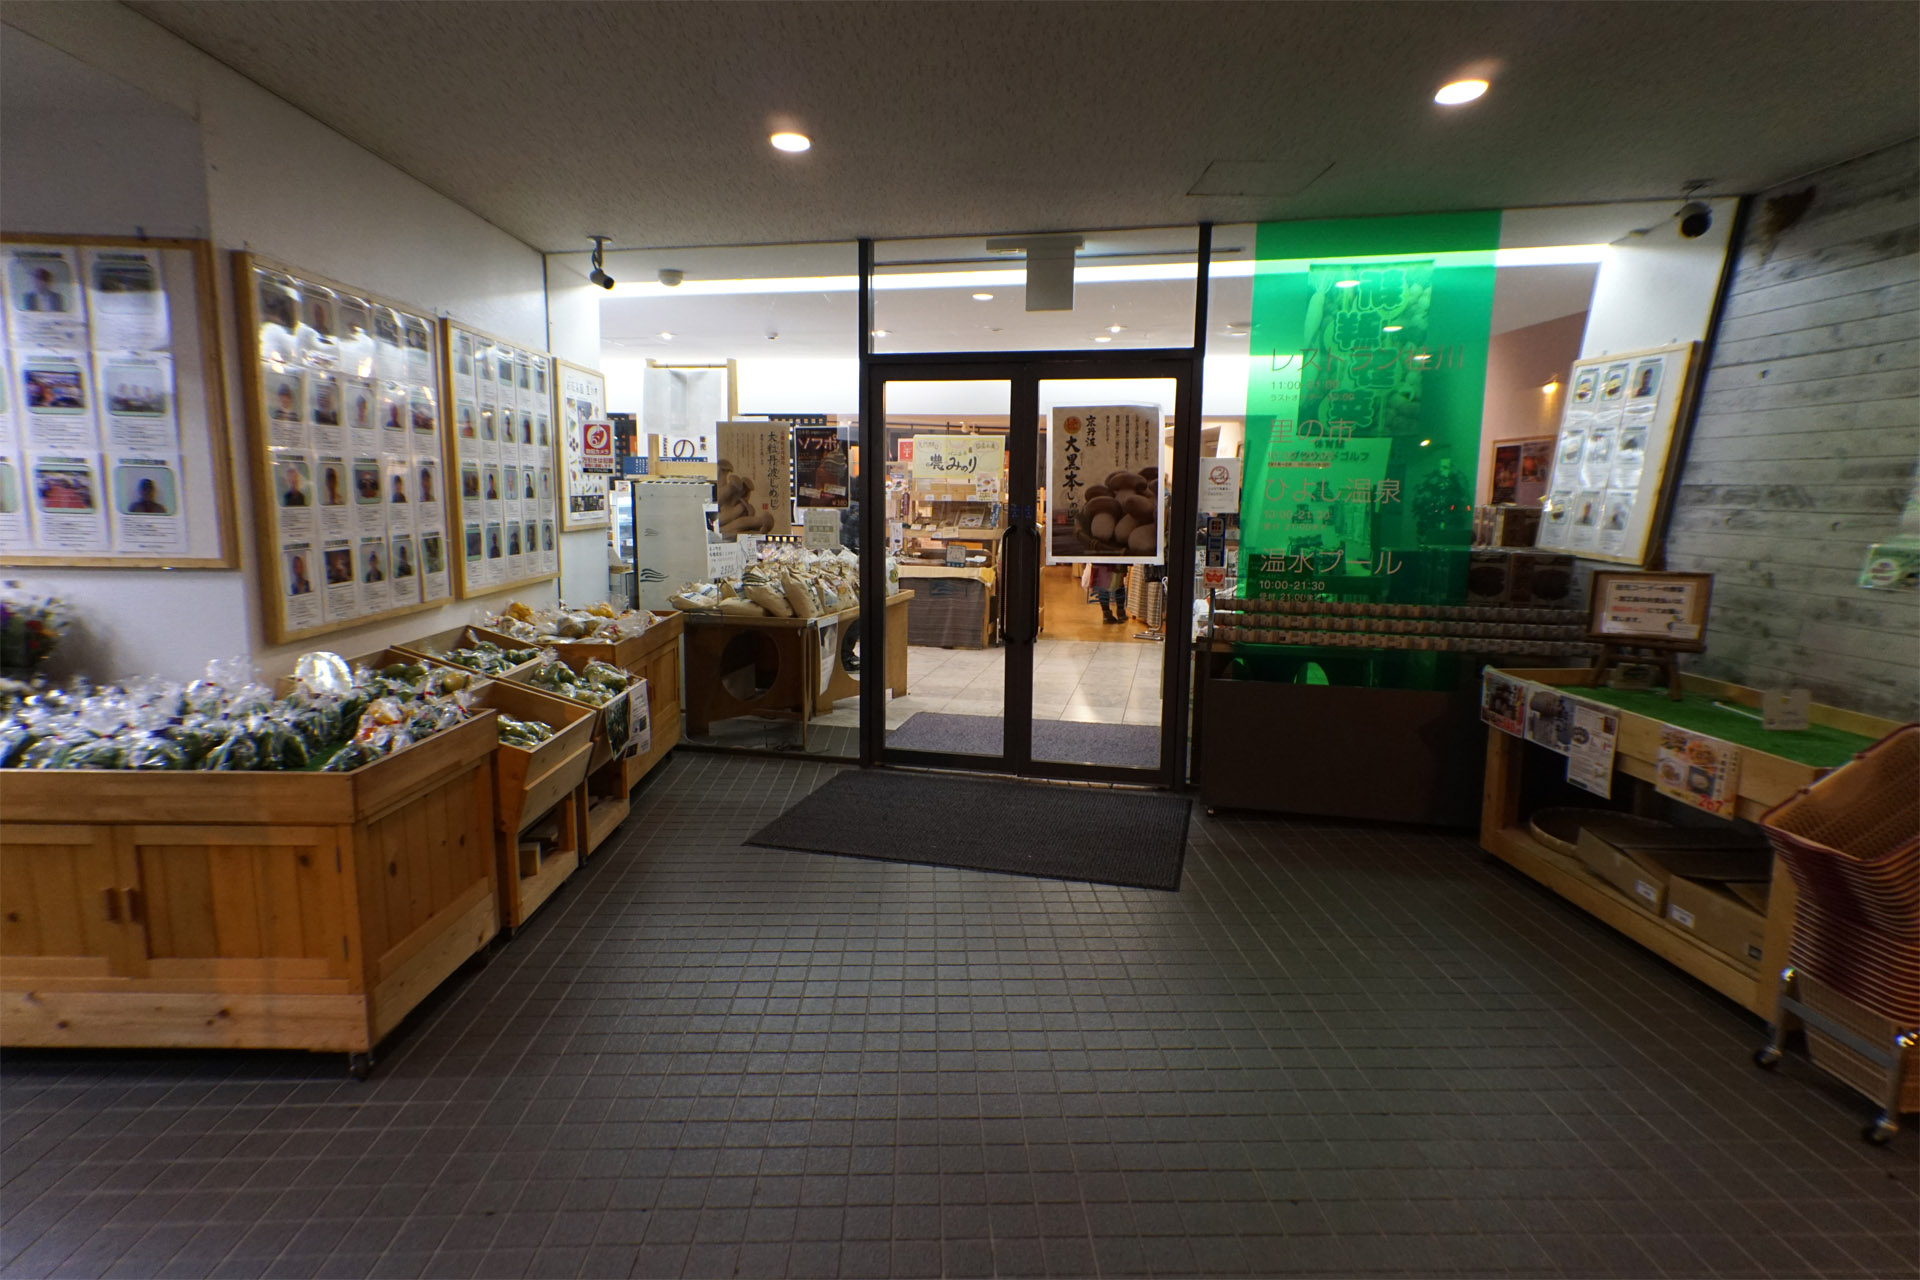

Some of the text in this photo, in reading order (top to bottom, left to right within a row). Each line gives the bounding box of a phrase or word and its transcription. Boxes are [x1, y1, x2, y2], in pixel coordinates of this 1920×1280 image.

[1270, 344, 1464, 373] レストラン桂川
[1085, 414, 1097, 447] 京丹波
[1269, 418, 1353, 444] 里の市
[1062, 435, 1085, 519] 大黒本しめじ
[1264, 478, 1401, 504] ひよし温泉
[1260, 548, 1402, 575] 温水プール
[1260, 580, 1326, 591] 10:00-21:30
